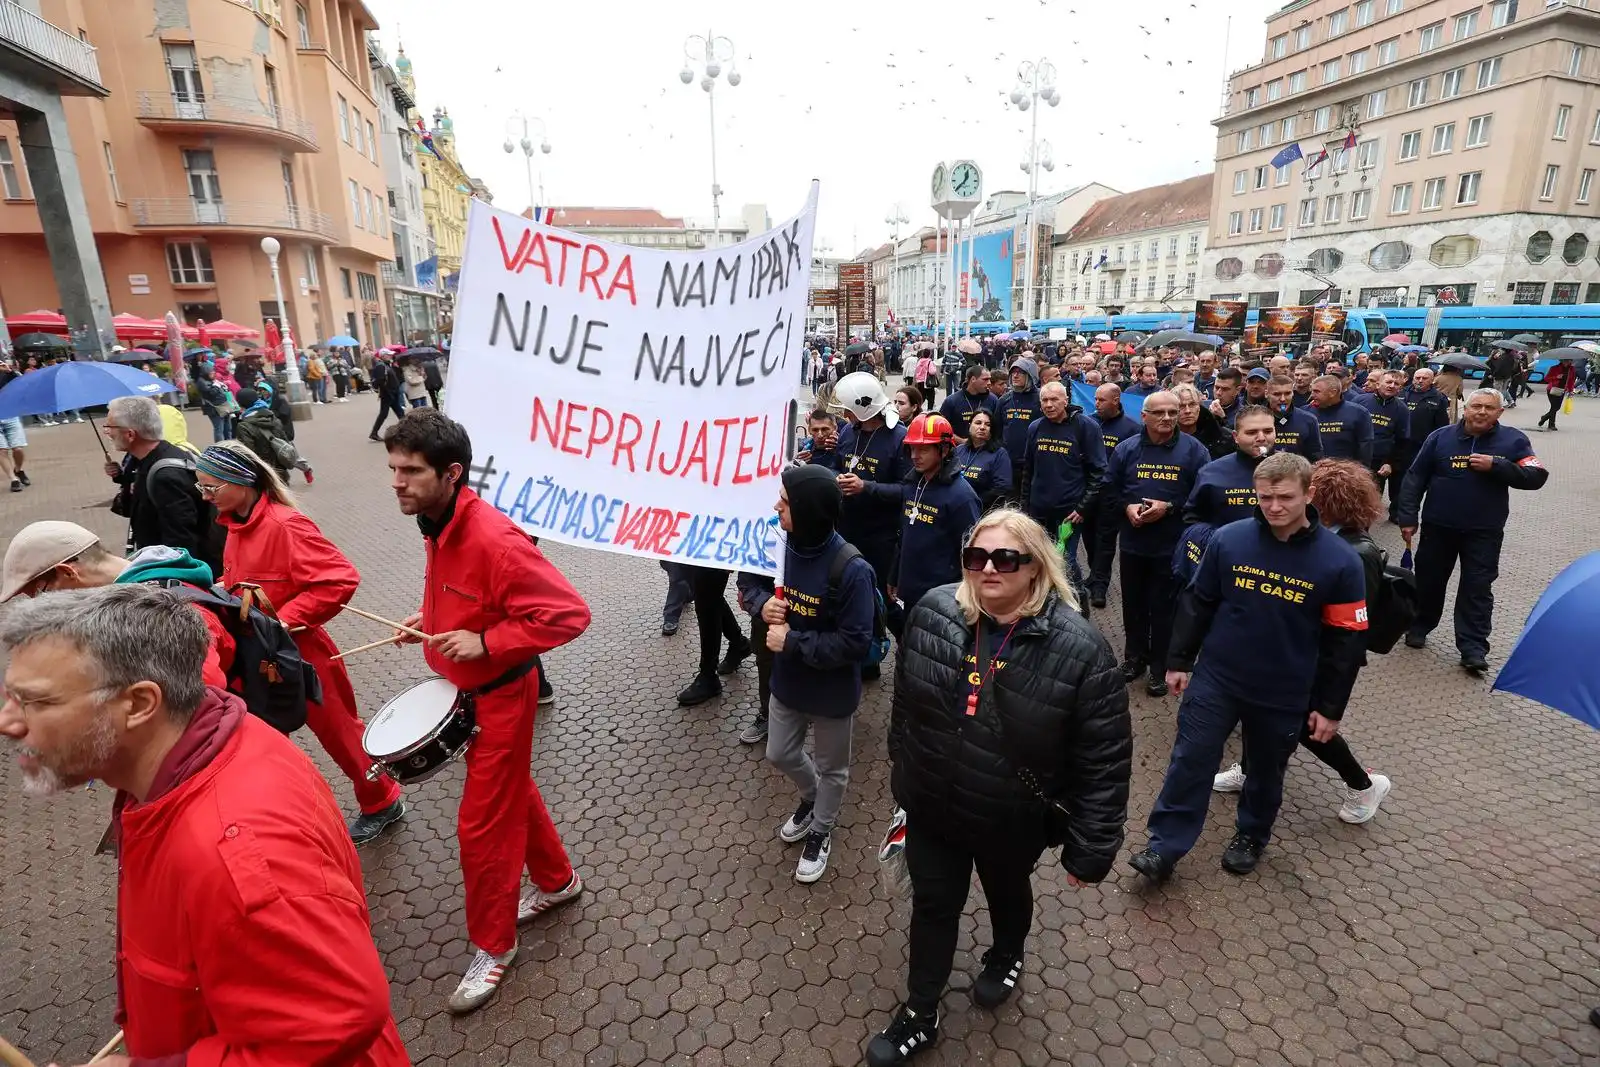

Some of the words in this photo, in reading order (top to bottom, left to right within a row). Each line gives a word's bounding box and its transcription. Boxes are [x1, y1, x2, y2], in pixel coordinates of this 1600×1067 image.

[492, 216, 637, 306] VATRA
[656, 254, 742, 309] NAM
[748, 218, 802, 300] IPAK
[488, 292, 609, 376] NIJE
[634, 306, 793, 387] NAJVEĆI
[530, 396, 788, 486] NEPRIJATELJ
[1049, 445, 1070, 454] GASE
[1137, 471, 1150, 479] NE
[1152, 472, 1178, 481] GASE
[1228, 497, 1245, 505] NE
[1232, 564, 1266, 577] LAŽIMA
[1268, 572, 1281, 581] SE
[1283, 575, 1315, 590] VATRE
[1235, 576, 1256, 590] NE
[1260, 582, 1306, 604] GASE
[799, 591, 821, 605] VATRE
